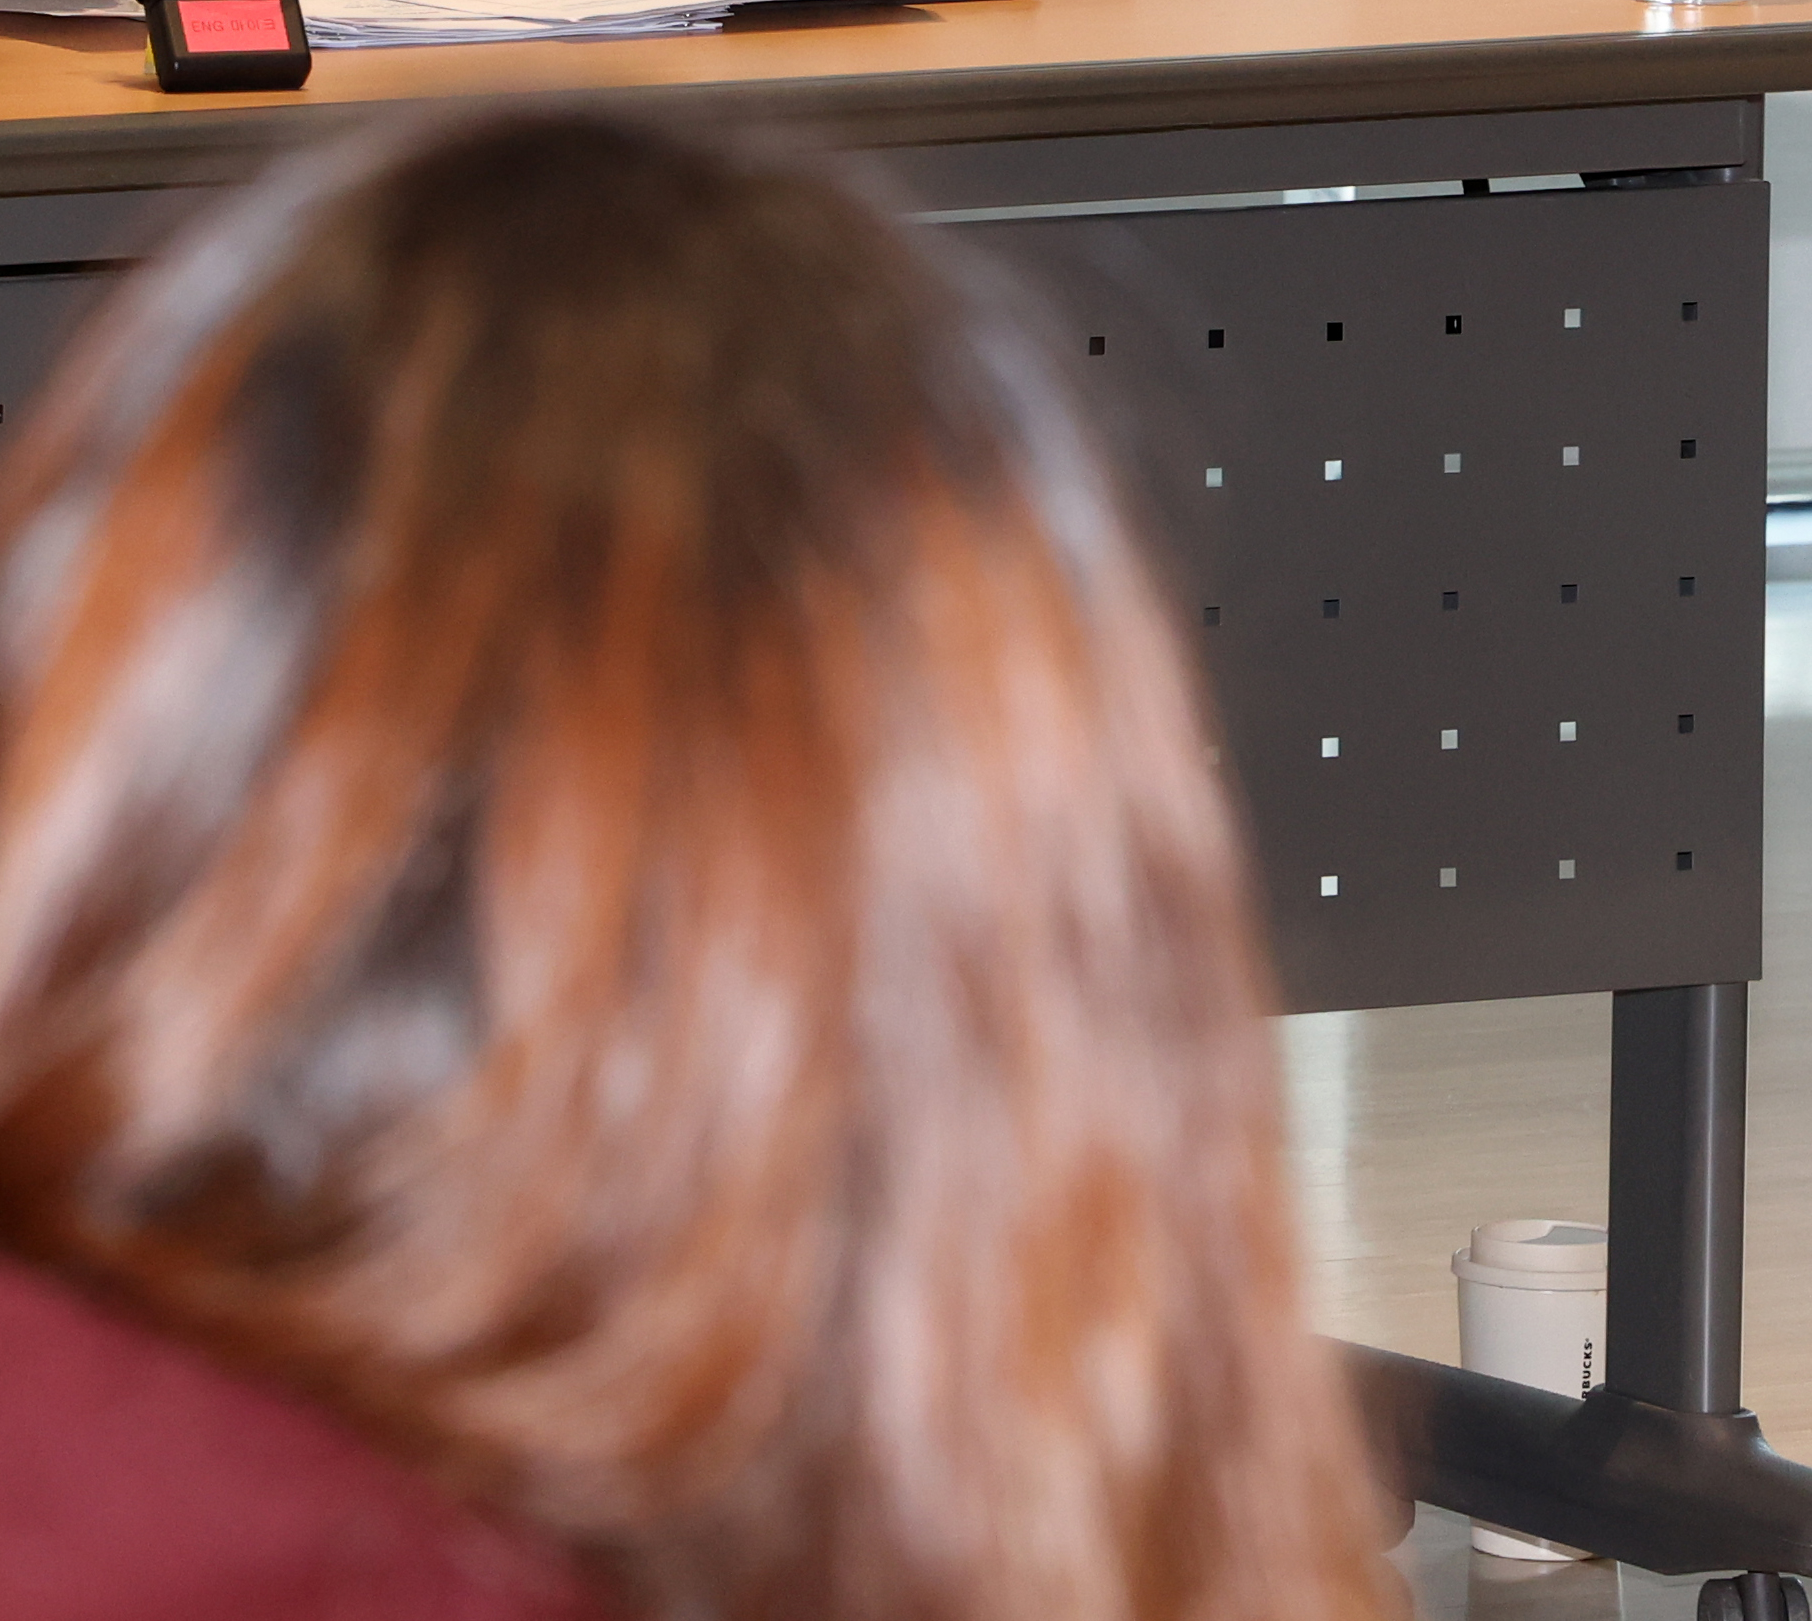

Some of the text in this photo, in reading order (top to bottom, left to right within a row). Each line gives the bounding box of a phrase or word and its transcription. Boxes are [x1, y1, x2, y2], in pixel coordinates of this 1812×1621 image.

[191, 19, 276, 33] ENG 마이크
[1581, 1342, 1592, 1399] RBUCKS
